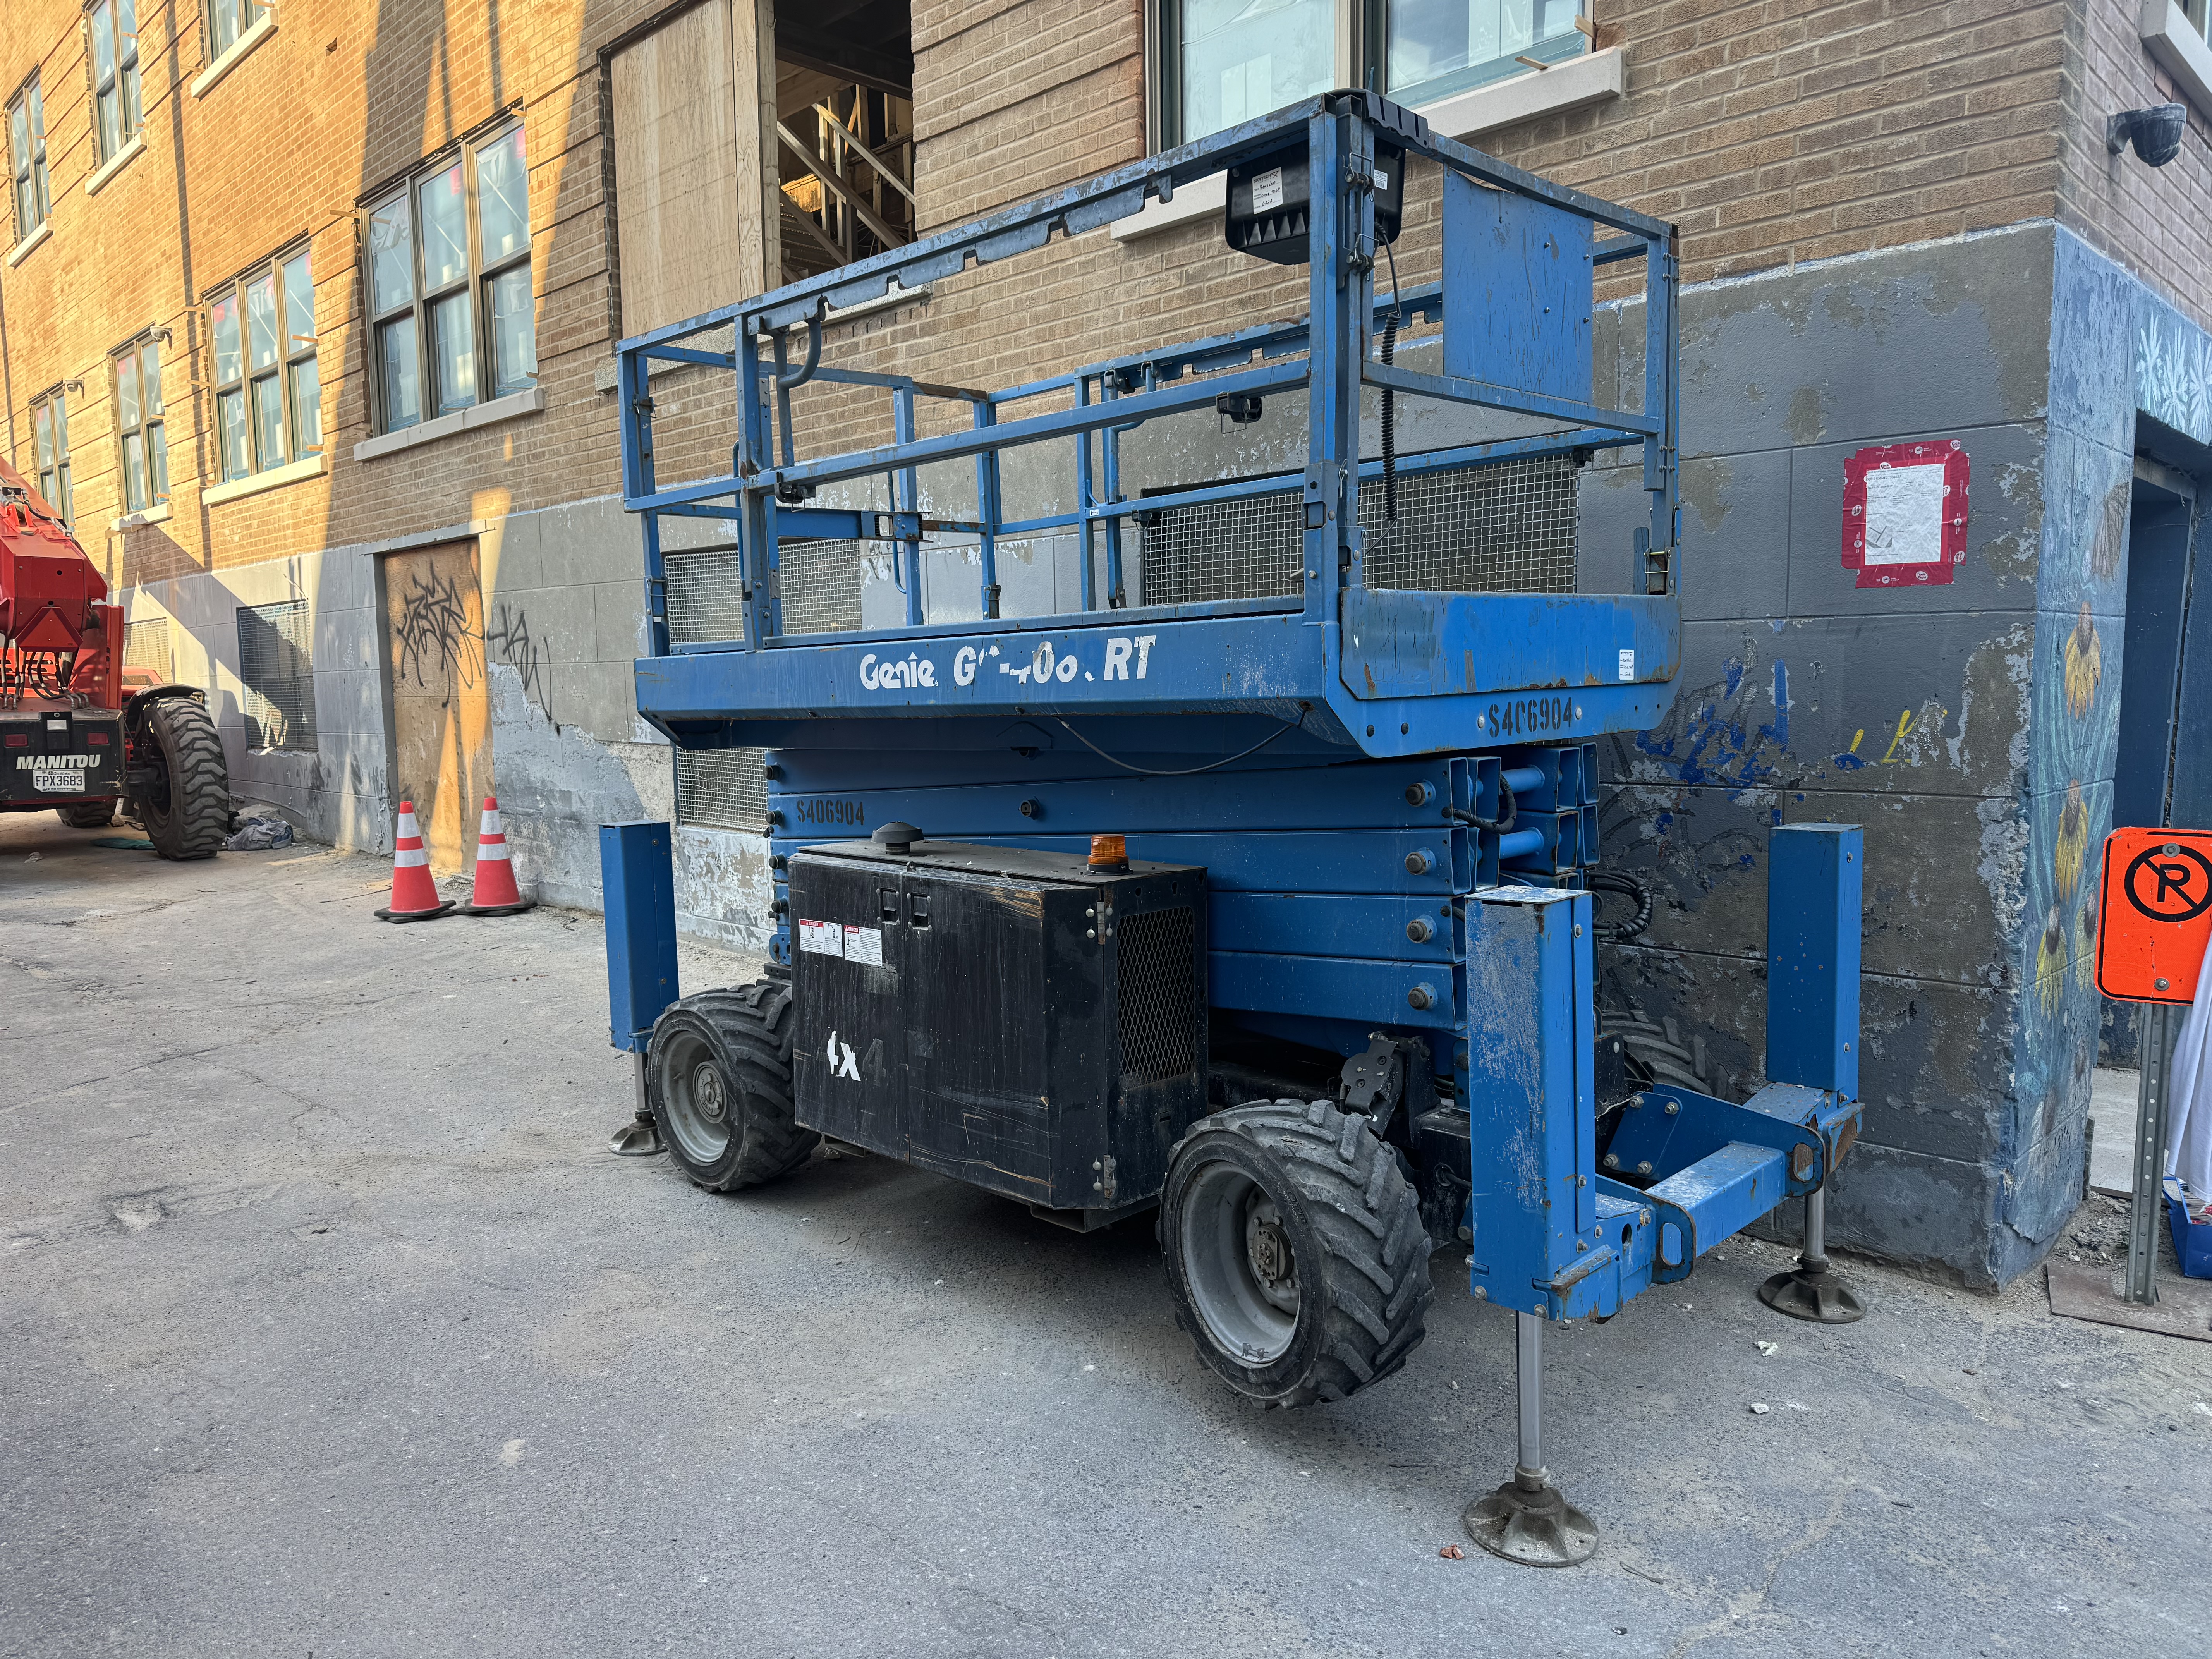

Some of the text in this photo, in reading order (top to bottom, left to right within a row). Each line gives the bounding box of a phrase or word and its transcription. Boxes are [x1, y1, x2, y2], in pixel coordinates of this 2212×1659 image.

[1254, 174, 1271, 183] SKYTECH
[860, 652, 936, 690] Genie
[1103, 635, 1157, 681] RT
[1489, 697, 1572, 738] S406904
[16, 754, 101, 770] MANITOU
[36, 775, 82, 786] FPX3683
[797, 799, 865, 826] S406904
